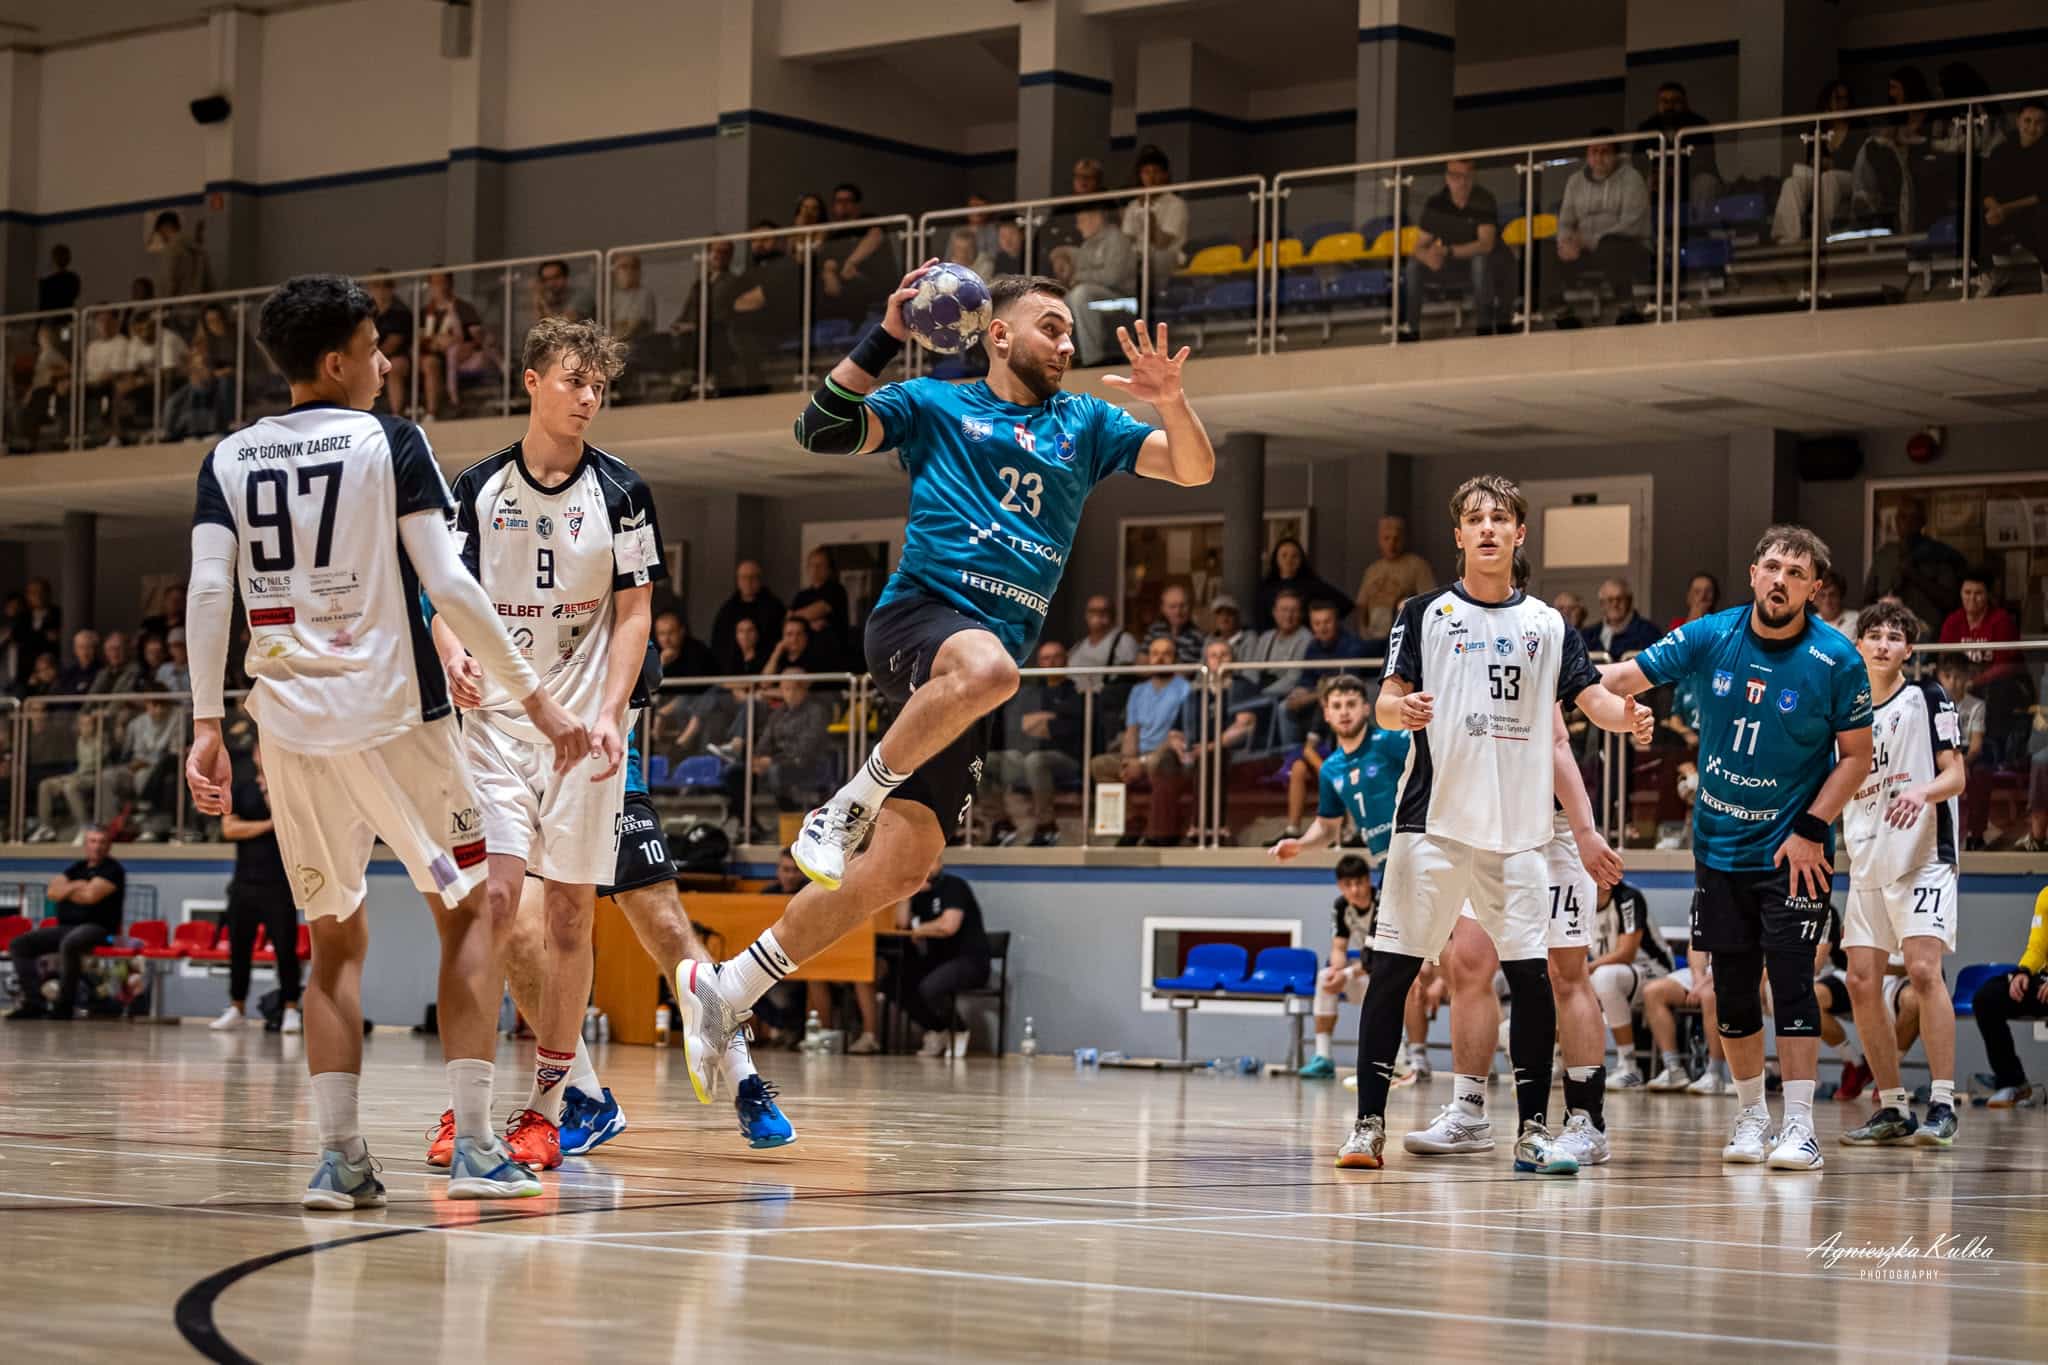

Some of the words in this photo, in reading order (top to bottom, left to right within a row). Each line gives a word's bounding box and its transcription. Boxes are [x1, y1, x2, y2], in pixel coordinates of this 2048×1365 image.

[260, 441, 303, 459] GÓRNIK
[307, 434, 352, 455] ZABRZE
[999, 466, 1044, 518] 23
[247, 461, 344, 572] 97
[536, 548, 554, 588] 9
[1007, 535, 1062, 567] TEXOM
[493, 603, 544, 617] ELBET
[957, 569, 1049, 617] TECH-PROJEC
[1488, 665, 1521, 700] 53
[1733, 717, 1761, 756] 11
[1722, 769, 1778, 787] TEXOM
[639, 840, 665, 865] 10
[1549, 885, 1580, 919] 74
[1913, 887, 1942, 914] 27
